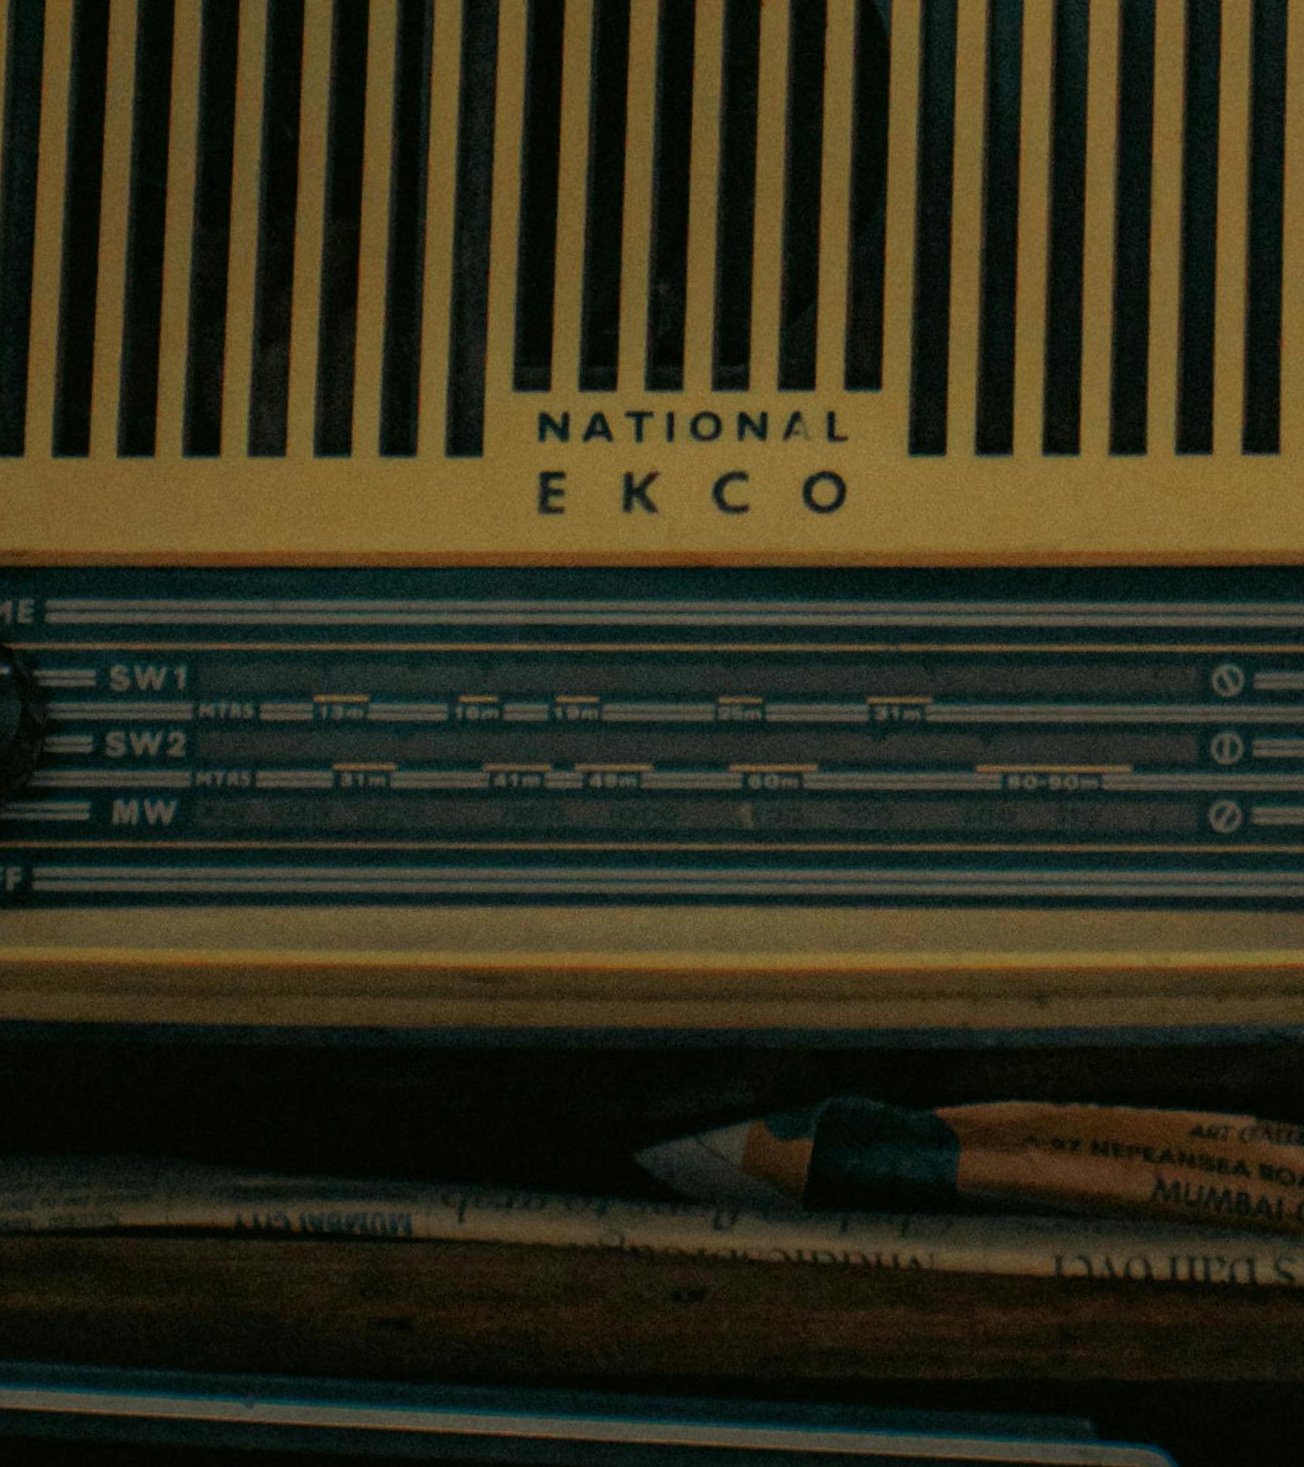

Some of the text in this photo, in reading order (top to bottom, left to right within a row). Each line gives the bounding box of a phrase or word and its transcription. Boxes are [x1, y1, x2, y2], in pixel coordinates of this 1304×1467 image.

[538, 411, 848, 443] NATIONAL
[538, 470, 847, 514] EKCO
[109, 666, 188, 691] SW1
[104, 732, 186, 757] SW2
[110, 801, 178, 826] MW
